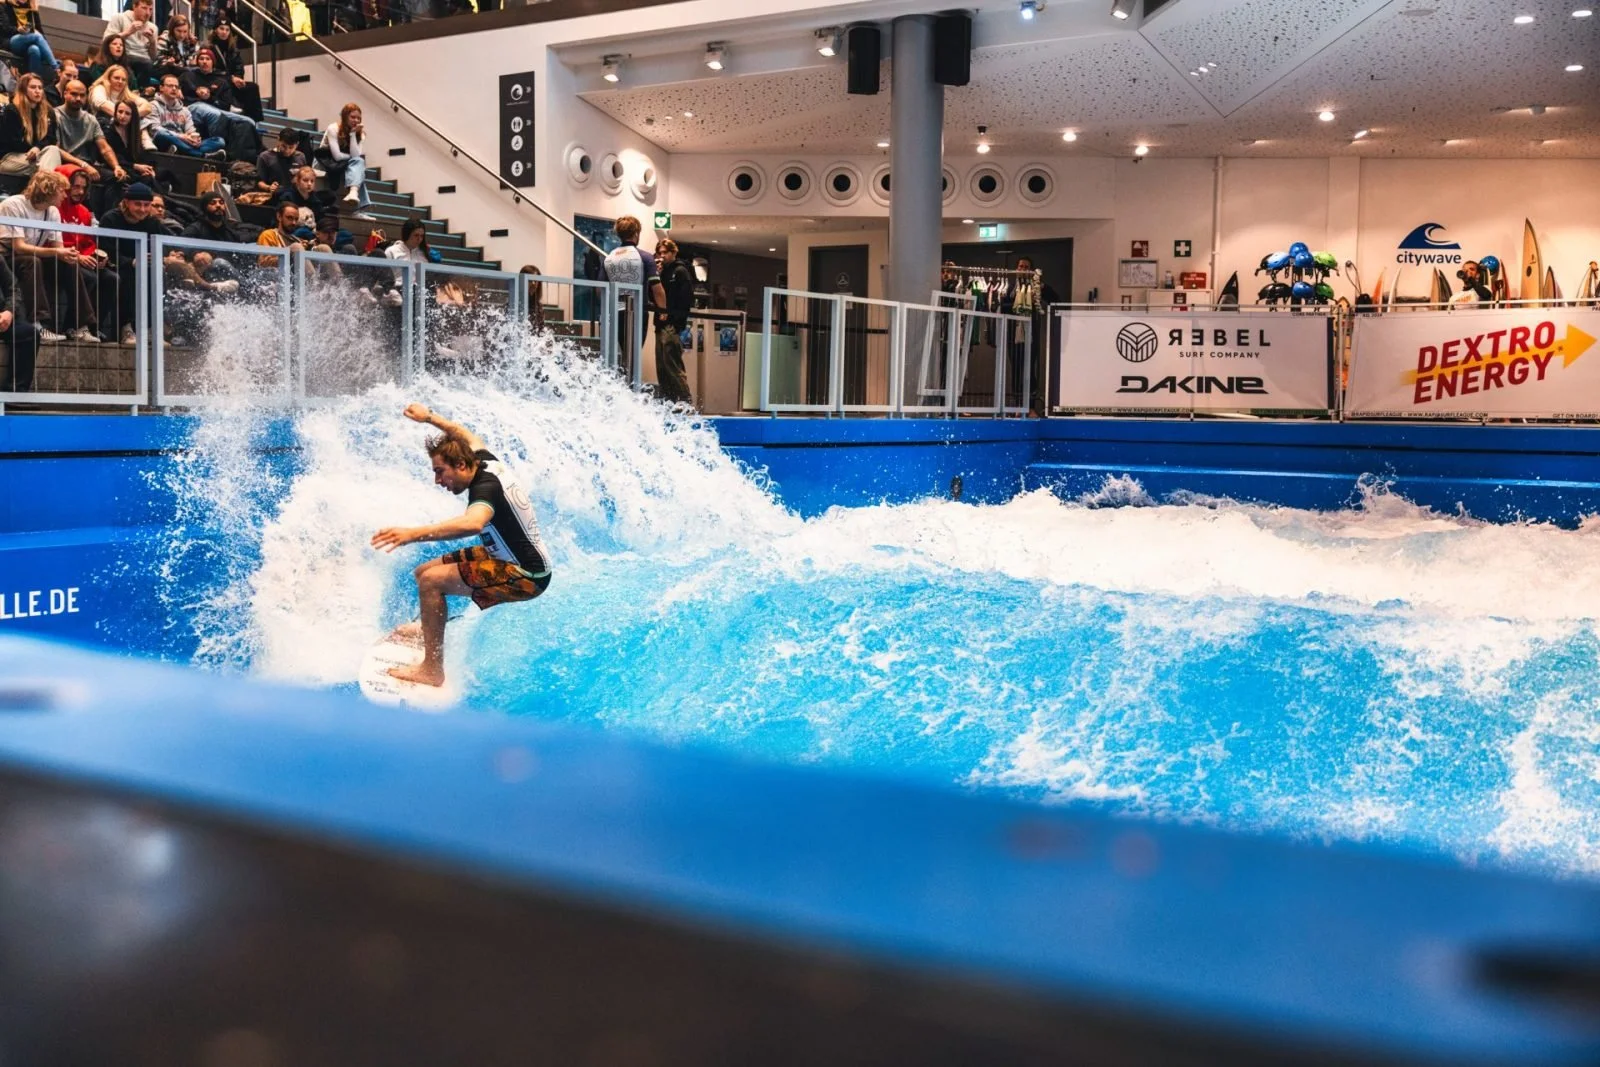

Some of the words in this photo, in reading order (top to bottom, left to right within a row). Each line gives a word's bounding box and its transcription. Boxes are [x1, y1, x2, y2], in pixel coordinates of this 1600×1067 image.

[1396, 251, 1462, 267] citywave
[1210, 351, 1260, 359] COMPANY
[1417, 321, 1556, 374] DEXTRO
[1115, 375, 1269, 395] DAKINE
[1414, 351, 1555, 404] ENERGY
[0, 587, 80, 620] LLE.DE
